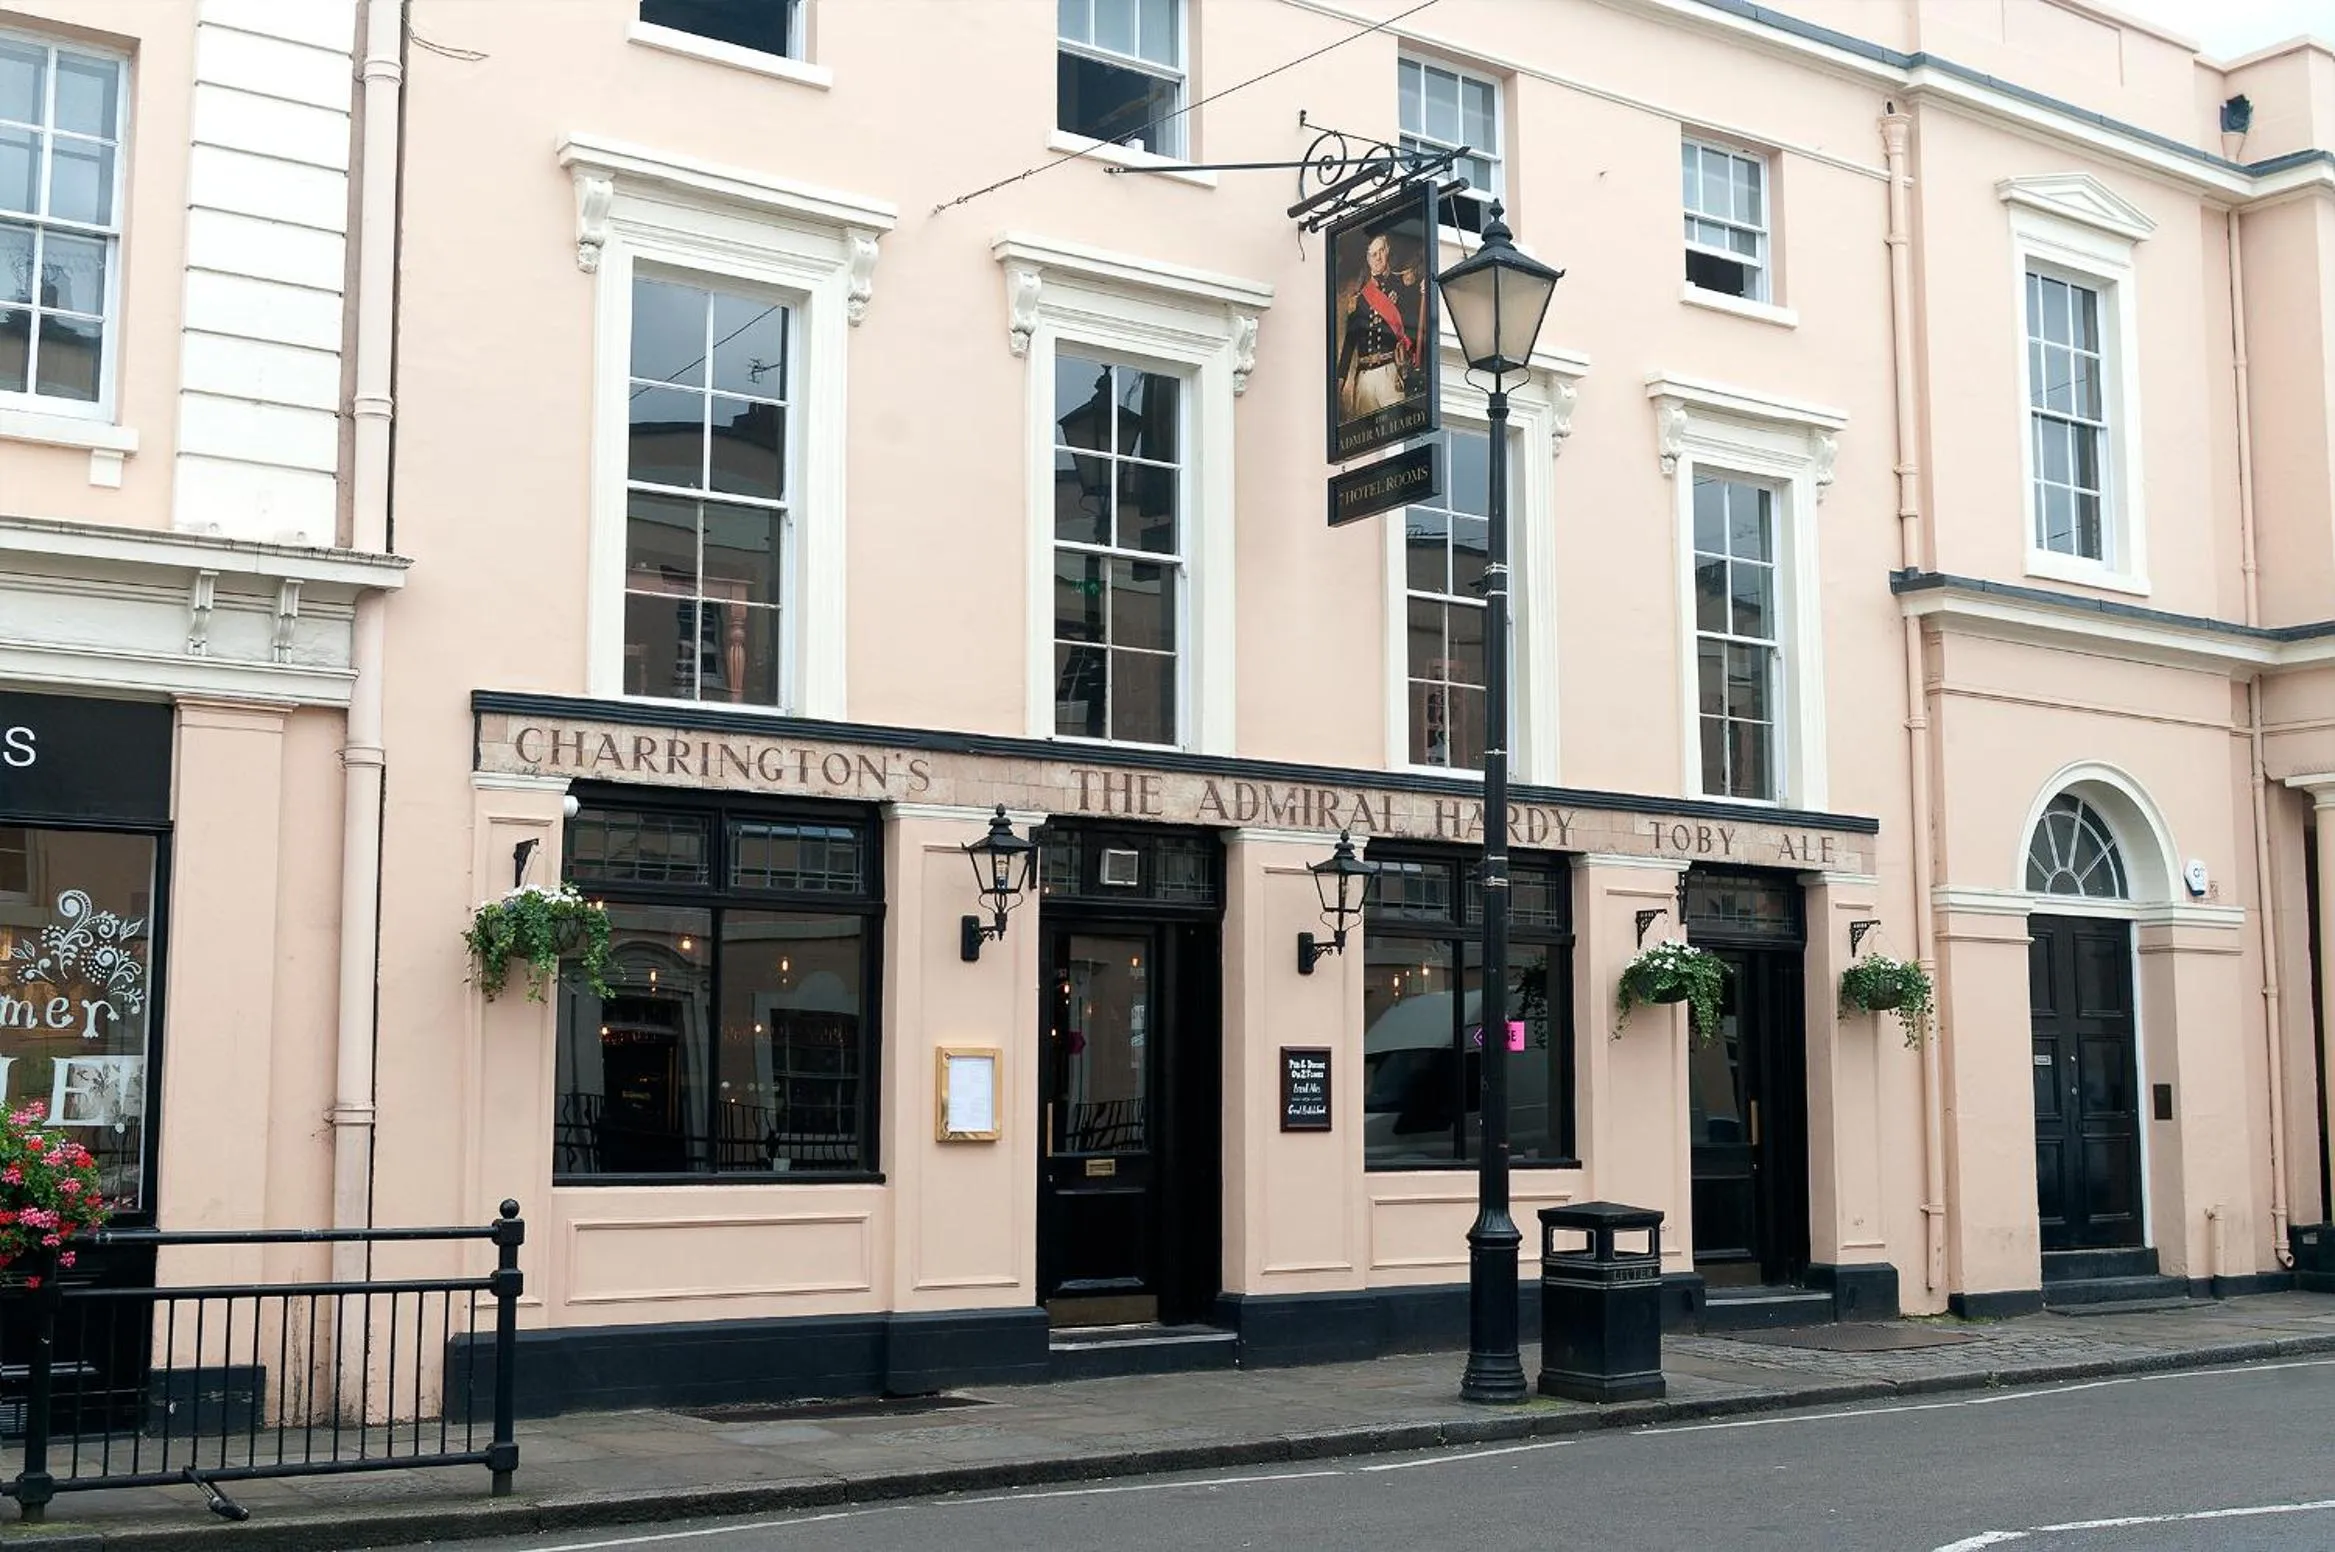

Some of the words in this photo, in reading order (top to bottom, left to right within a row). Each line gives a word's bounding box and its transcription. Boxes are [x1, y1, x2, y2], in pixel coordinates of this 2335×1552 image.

[1339, 425, 1388, 450] ADMIRAL
[1389, 410, 1425, 434] HARDY
[1345, 480, 1384, 505] HOTEL
[1386, 465, 1429, 491] ROOMS
[3, 726, 36, 767] S
[515, 726, 931, 793] CHARRINGTON'S
[1070, 768, 1163, 817] THE
[1195, 778, 1405, 834] ADMIRAL
[1649, 820, 1736, 856] TOBY
[1777, 833, 1836, 864] ALE
[1613, 1268, 1653, 1281] LITTER
